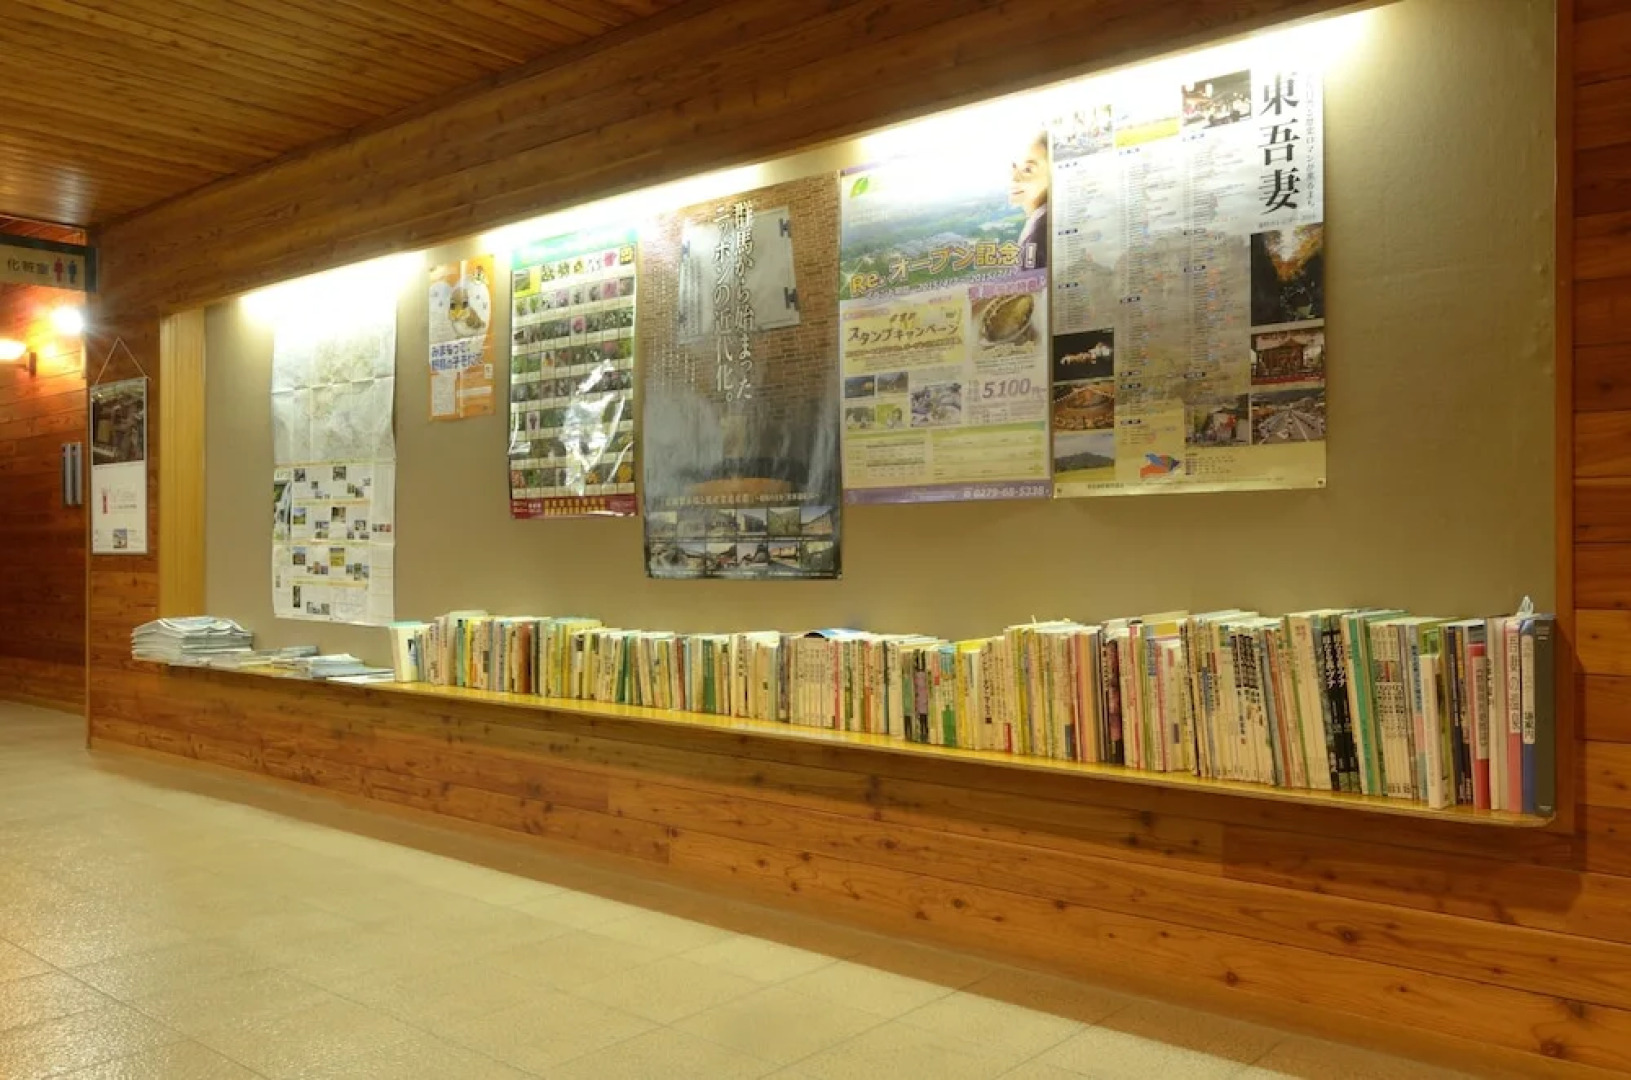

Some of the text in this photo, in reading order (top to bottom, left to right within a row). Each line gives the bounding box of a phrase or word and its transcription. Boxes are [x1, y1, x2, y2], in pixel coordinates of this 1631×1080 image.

[1258, 70, 1301, 216] 東吾妻
[733, 199, 756, 399] 群馬から始まった
[847, 323, 959, 345] スタンプキャンペーン
